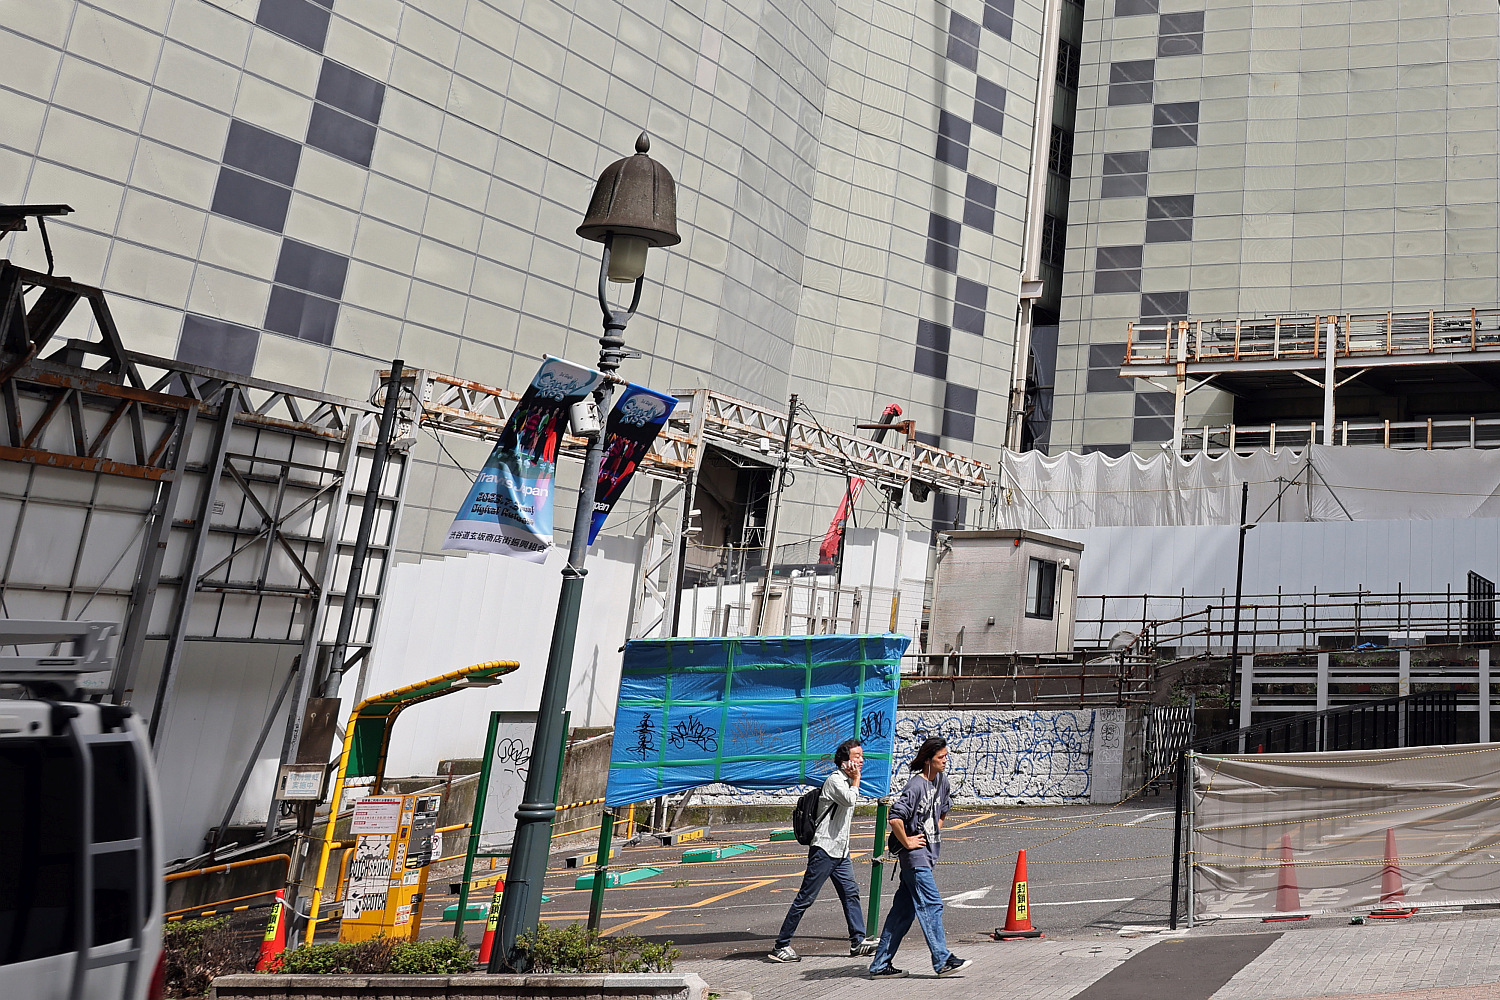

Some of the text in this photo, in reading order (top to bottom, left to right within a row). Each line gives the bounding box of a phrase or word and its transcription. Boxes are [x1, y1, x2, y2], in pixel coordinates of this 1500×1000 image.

[478, 472, 549, 498] Travis Japan
[1017, 883, 1026, 914] 封鎖中
